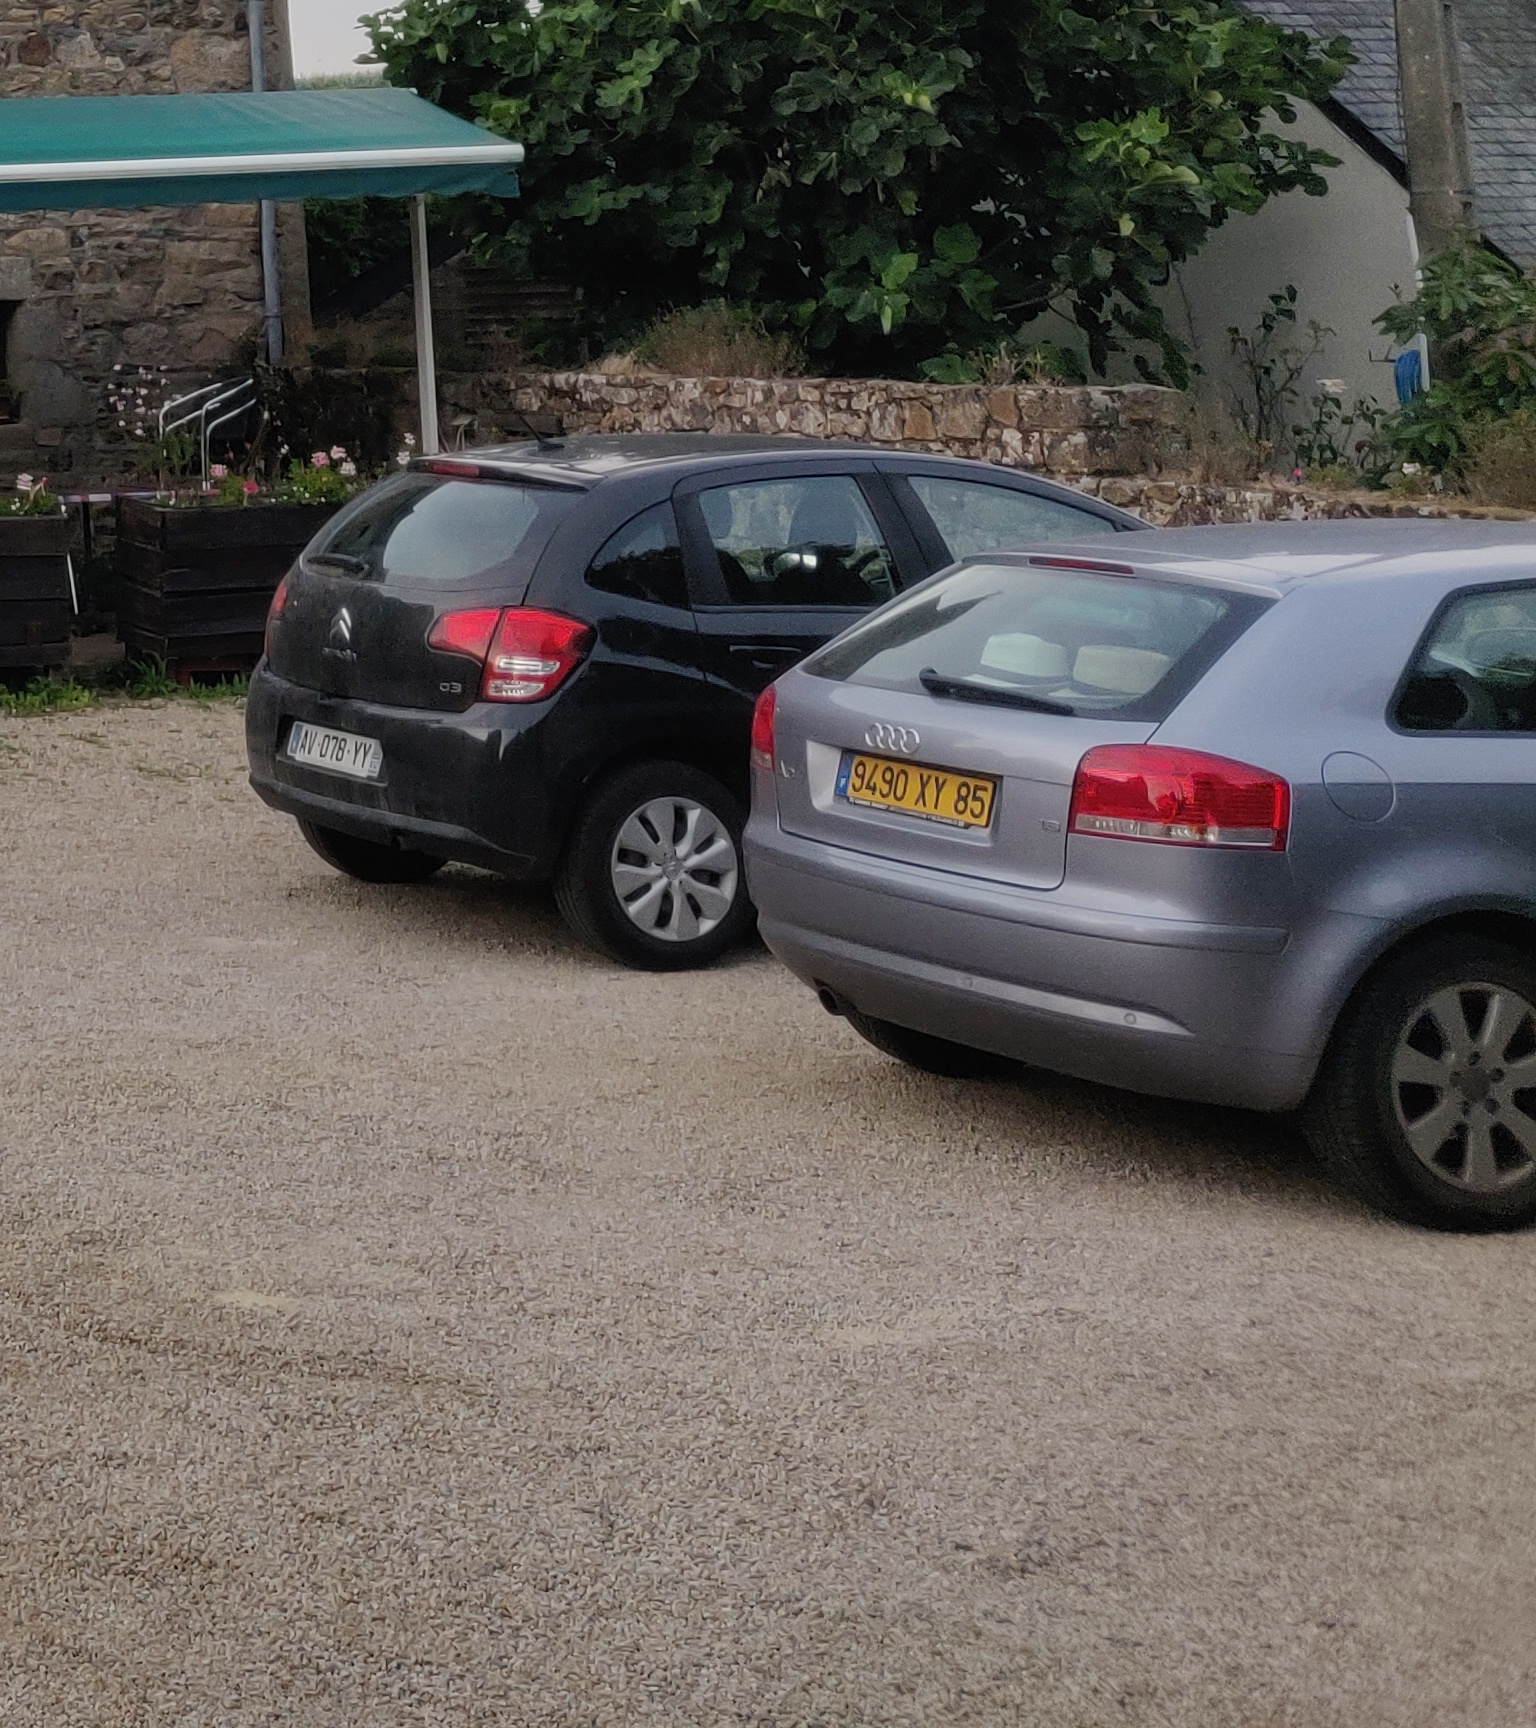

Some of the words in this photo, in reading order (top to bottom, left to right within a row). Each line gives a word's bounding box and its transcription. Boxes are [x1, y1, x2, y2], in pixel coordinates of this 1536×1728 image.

[852, 759, 909, 801] 9490
[914, 773, 948, 810] XY
[954, 781, 988, 819] 85
